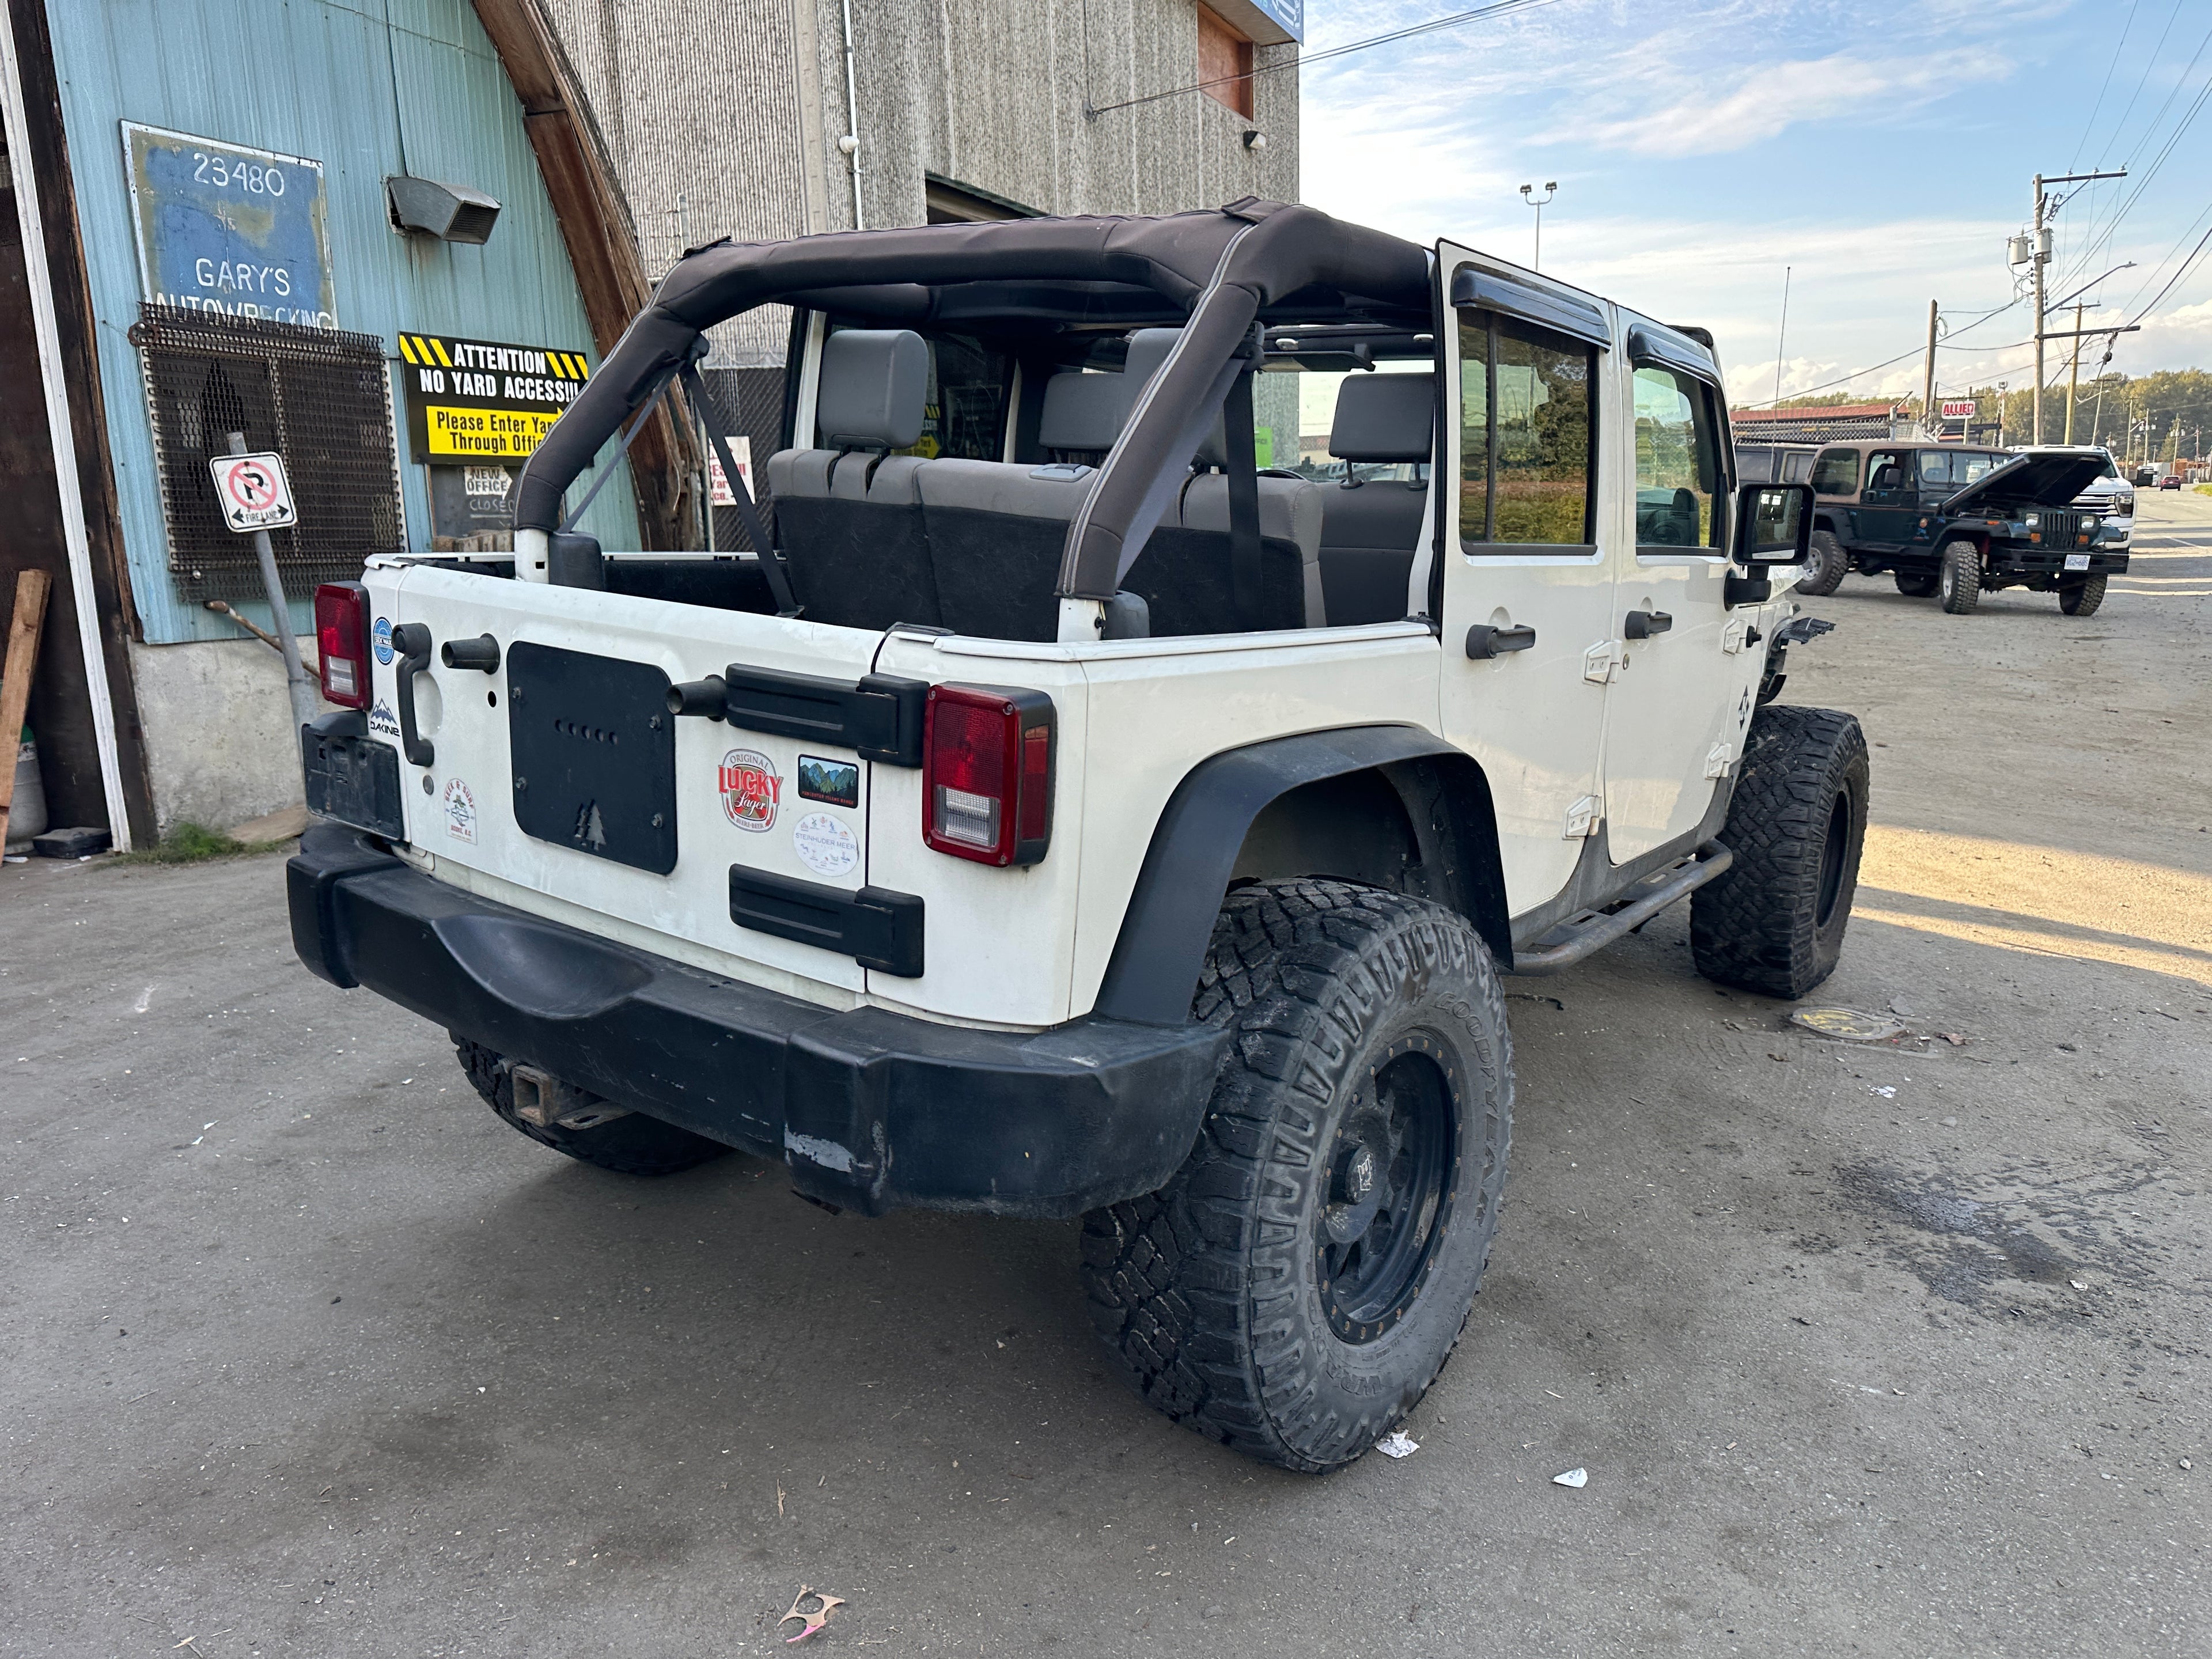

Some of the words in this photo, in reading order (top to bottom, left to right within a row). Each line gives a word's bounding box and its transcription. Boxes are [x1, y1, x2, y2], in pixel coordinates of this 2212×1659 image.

[194, 153, 285, 196] 23480
[196, 257, 290, 296] GARY'S
[454, 343, 546, 375] ATTENTION
[420, 369, 445, 393] NO
[451, 372, 497, 397] YARD
[504, 378, 578, 403] ACCESS!!!
[437, 411, 483, 431] Please
[490, 414, 526, 433] Enter
[531, 416, 558, 434] Yar
[450, 432, 507, 454] Through
[471, 467, 500, 479] NEW
[467, 478, 507, 493] OFFICE
[245, 513, 259, 523] FIRE
[370, 721, 400, 737] DAKINE
[730, 753, 768, 771] ORIGINAL
[718, 766, 783, 805] LUCKY
[734, 791, 766, 817] Lager
[796, 832, 835, 846] STEINHUDER
[836, 841, 855, 850] MEER
